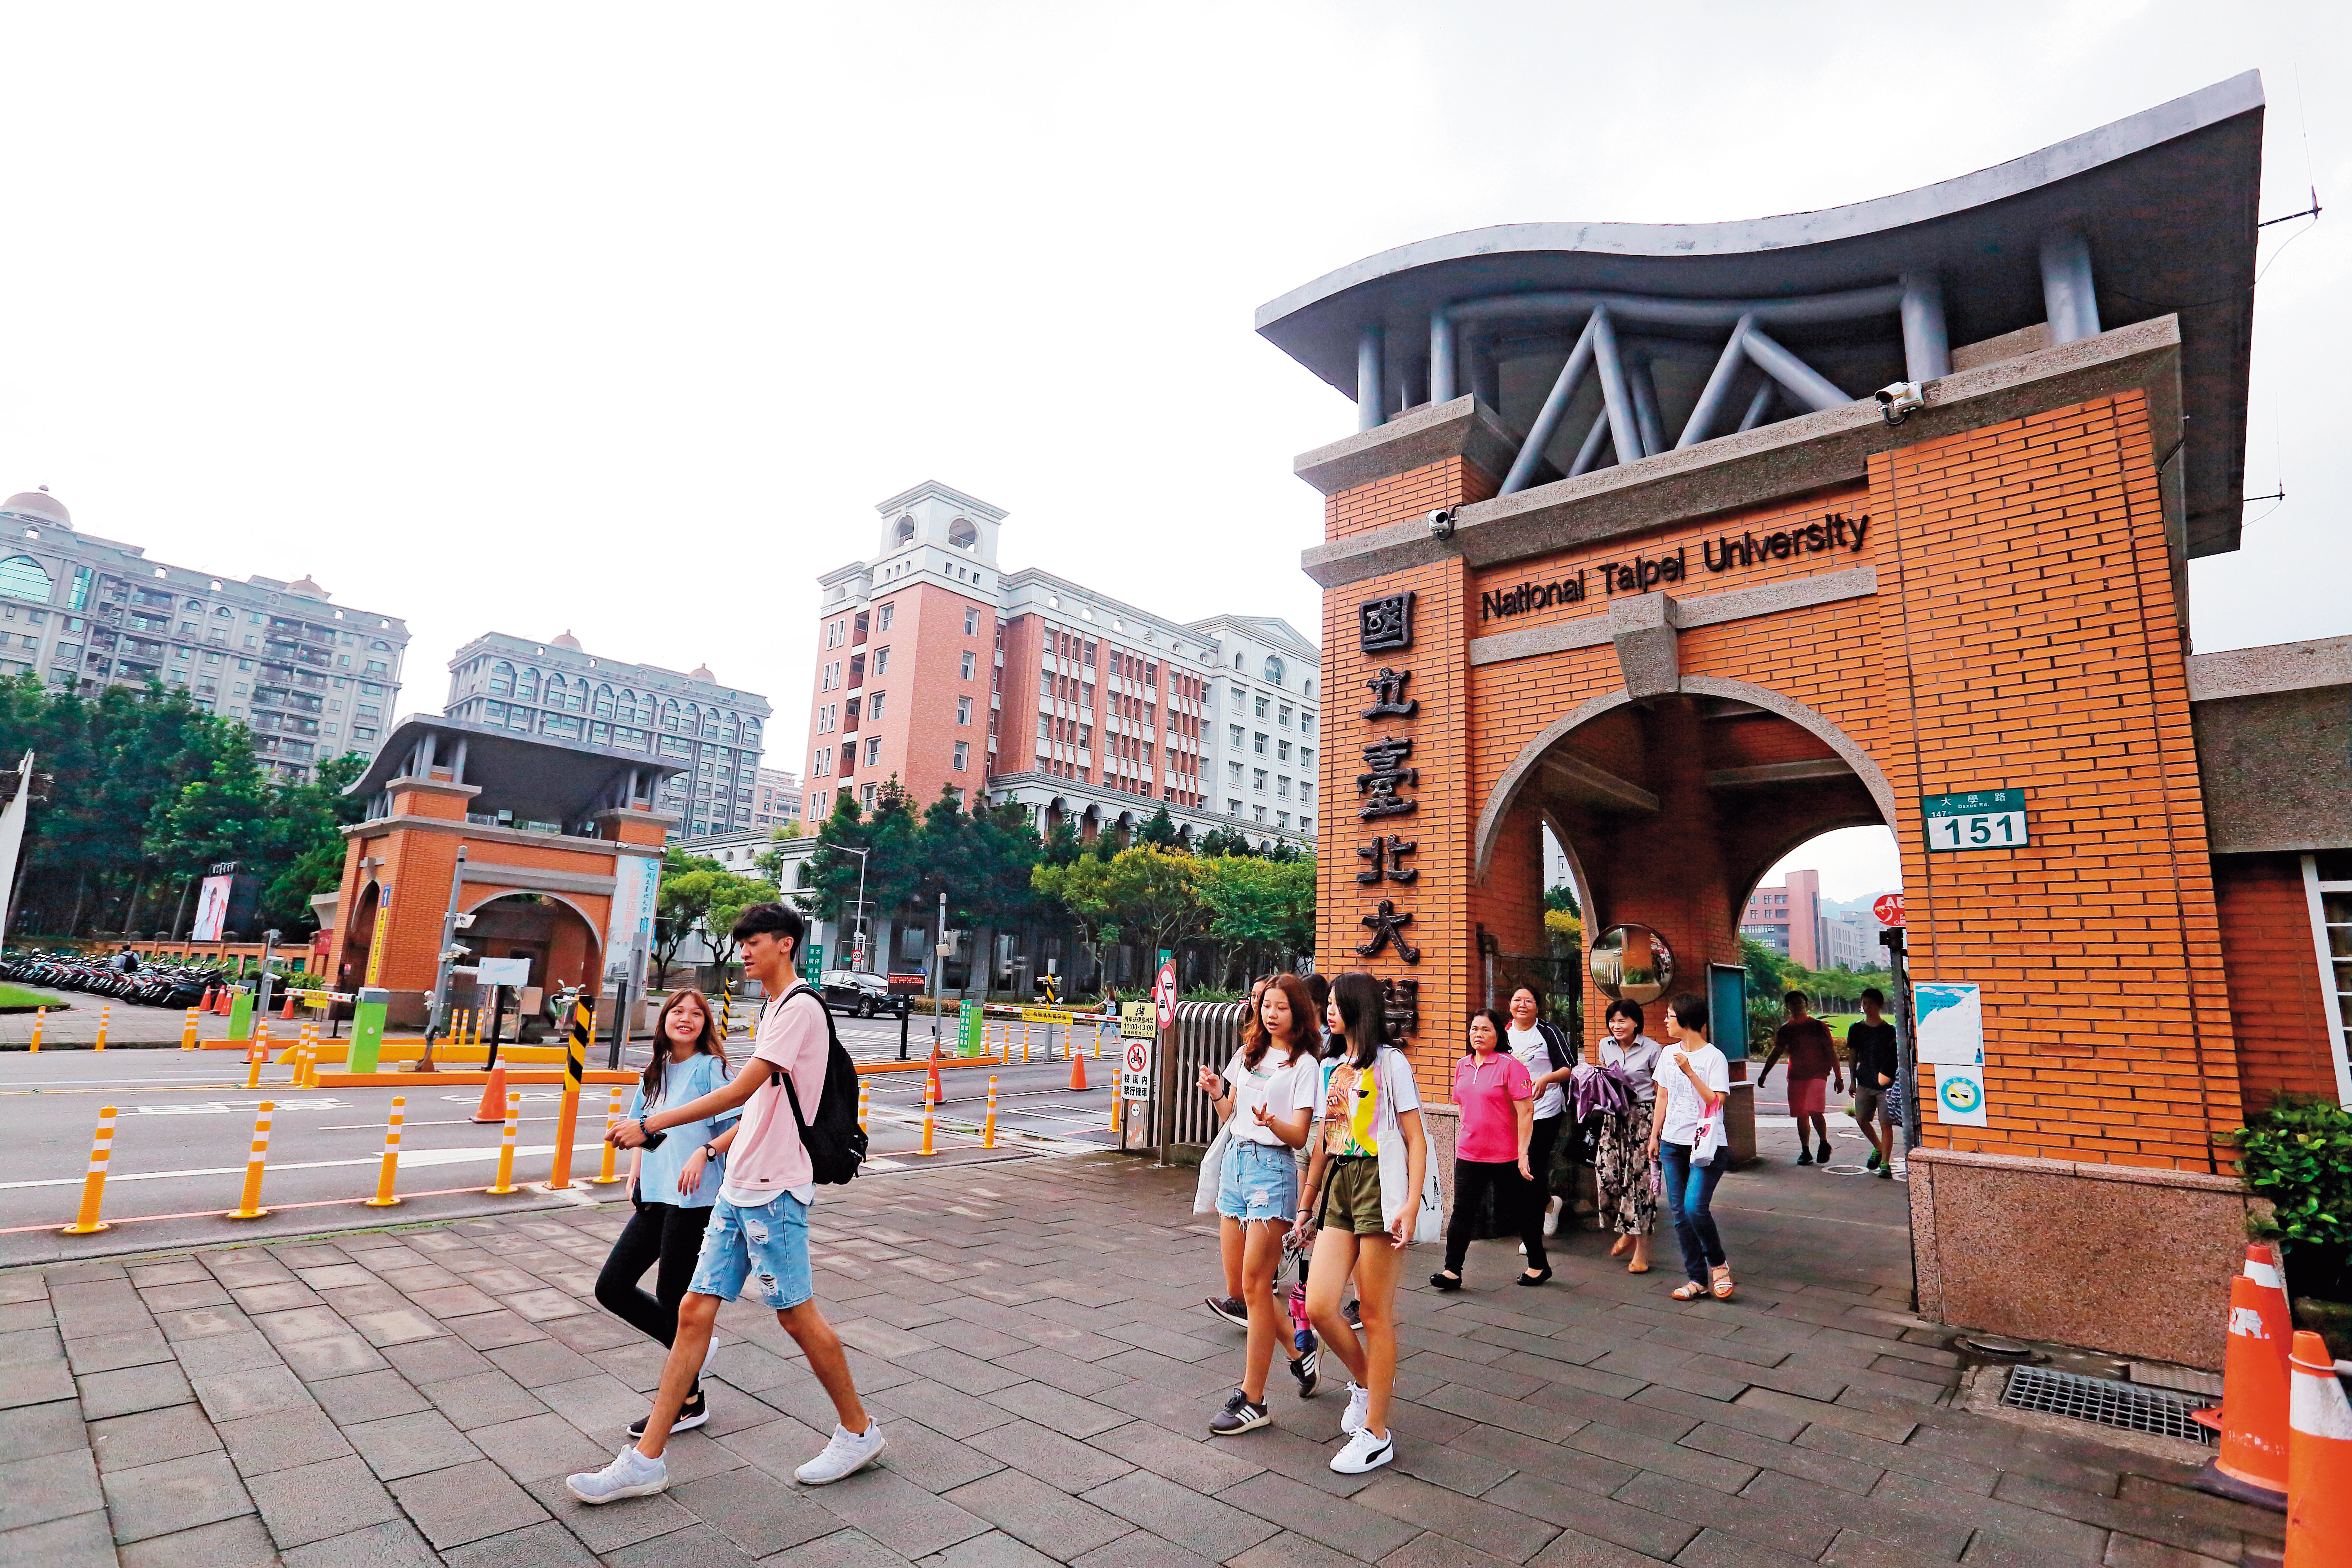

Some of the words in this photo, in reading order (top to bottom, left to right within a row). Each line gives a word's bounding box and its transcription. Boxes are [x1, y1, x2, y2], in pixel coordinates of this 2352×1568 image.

[1482, 568, 1584, 621] National
[1598, 545, 1685, 593] Taipei
[1703, 512, 1869, 572] University
[1941, 792, 2006, 806] 大學路
[1945, 815, 2013, 845] 151
[1124, 1023, 1153, 1031] 11:00-13:00
[1124, 1074, 1147, 1085] 校園內
[1124, 1085, 1147, 1097] 禁行機車
